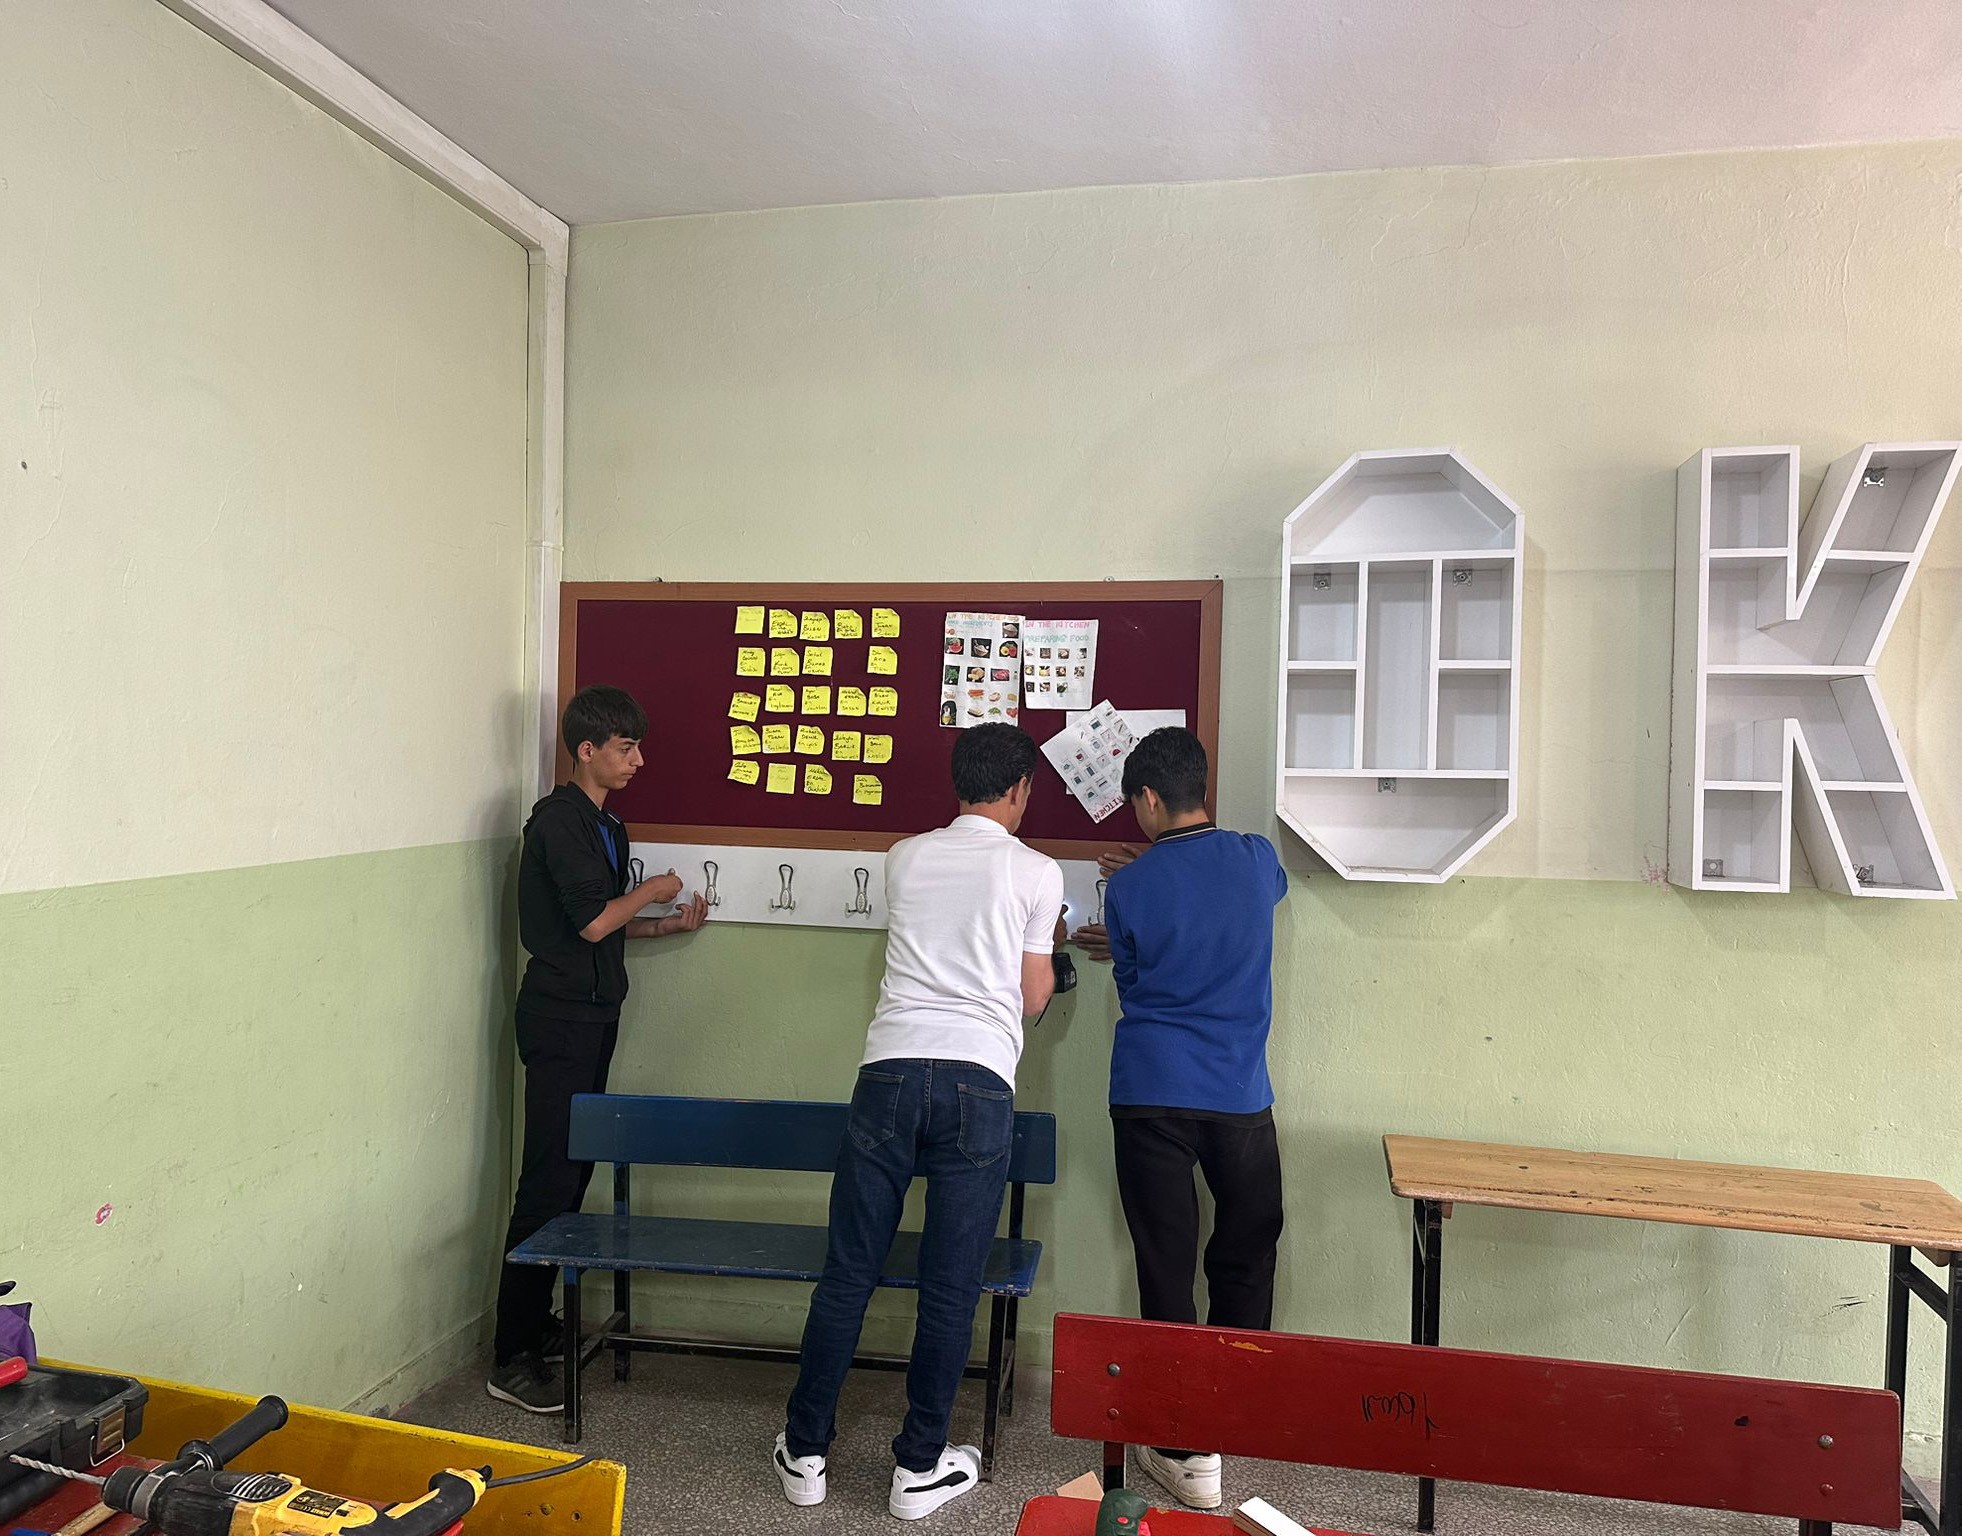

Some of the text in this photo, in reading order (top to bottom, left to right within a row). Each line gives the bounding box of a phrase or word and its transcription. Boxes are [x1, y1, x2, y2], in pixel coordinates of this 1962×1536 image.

[1024, 620, 1035, 628] IN
[1055, 620, 1091, 629] KITCHEN
[1069, 634, 1090, 642] FOOD
[1093, 796, 1124, 820] KITCHEN
